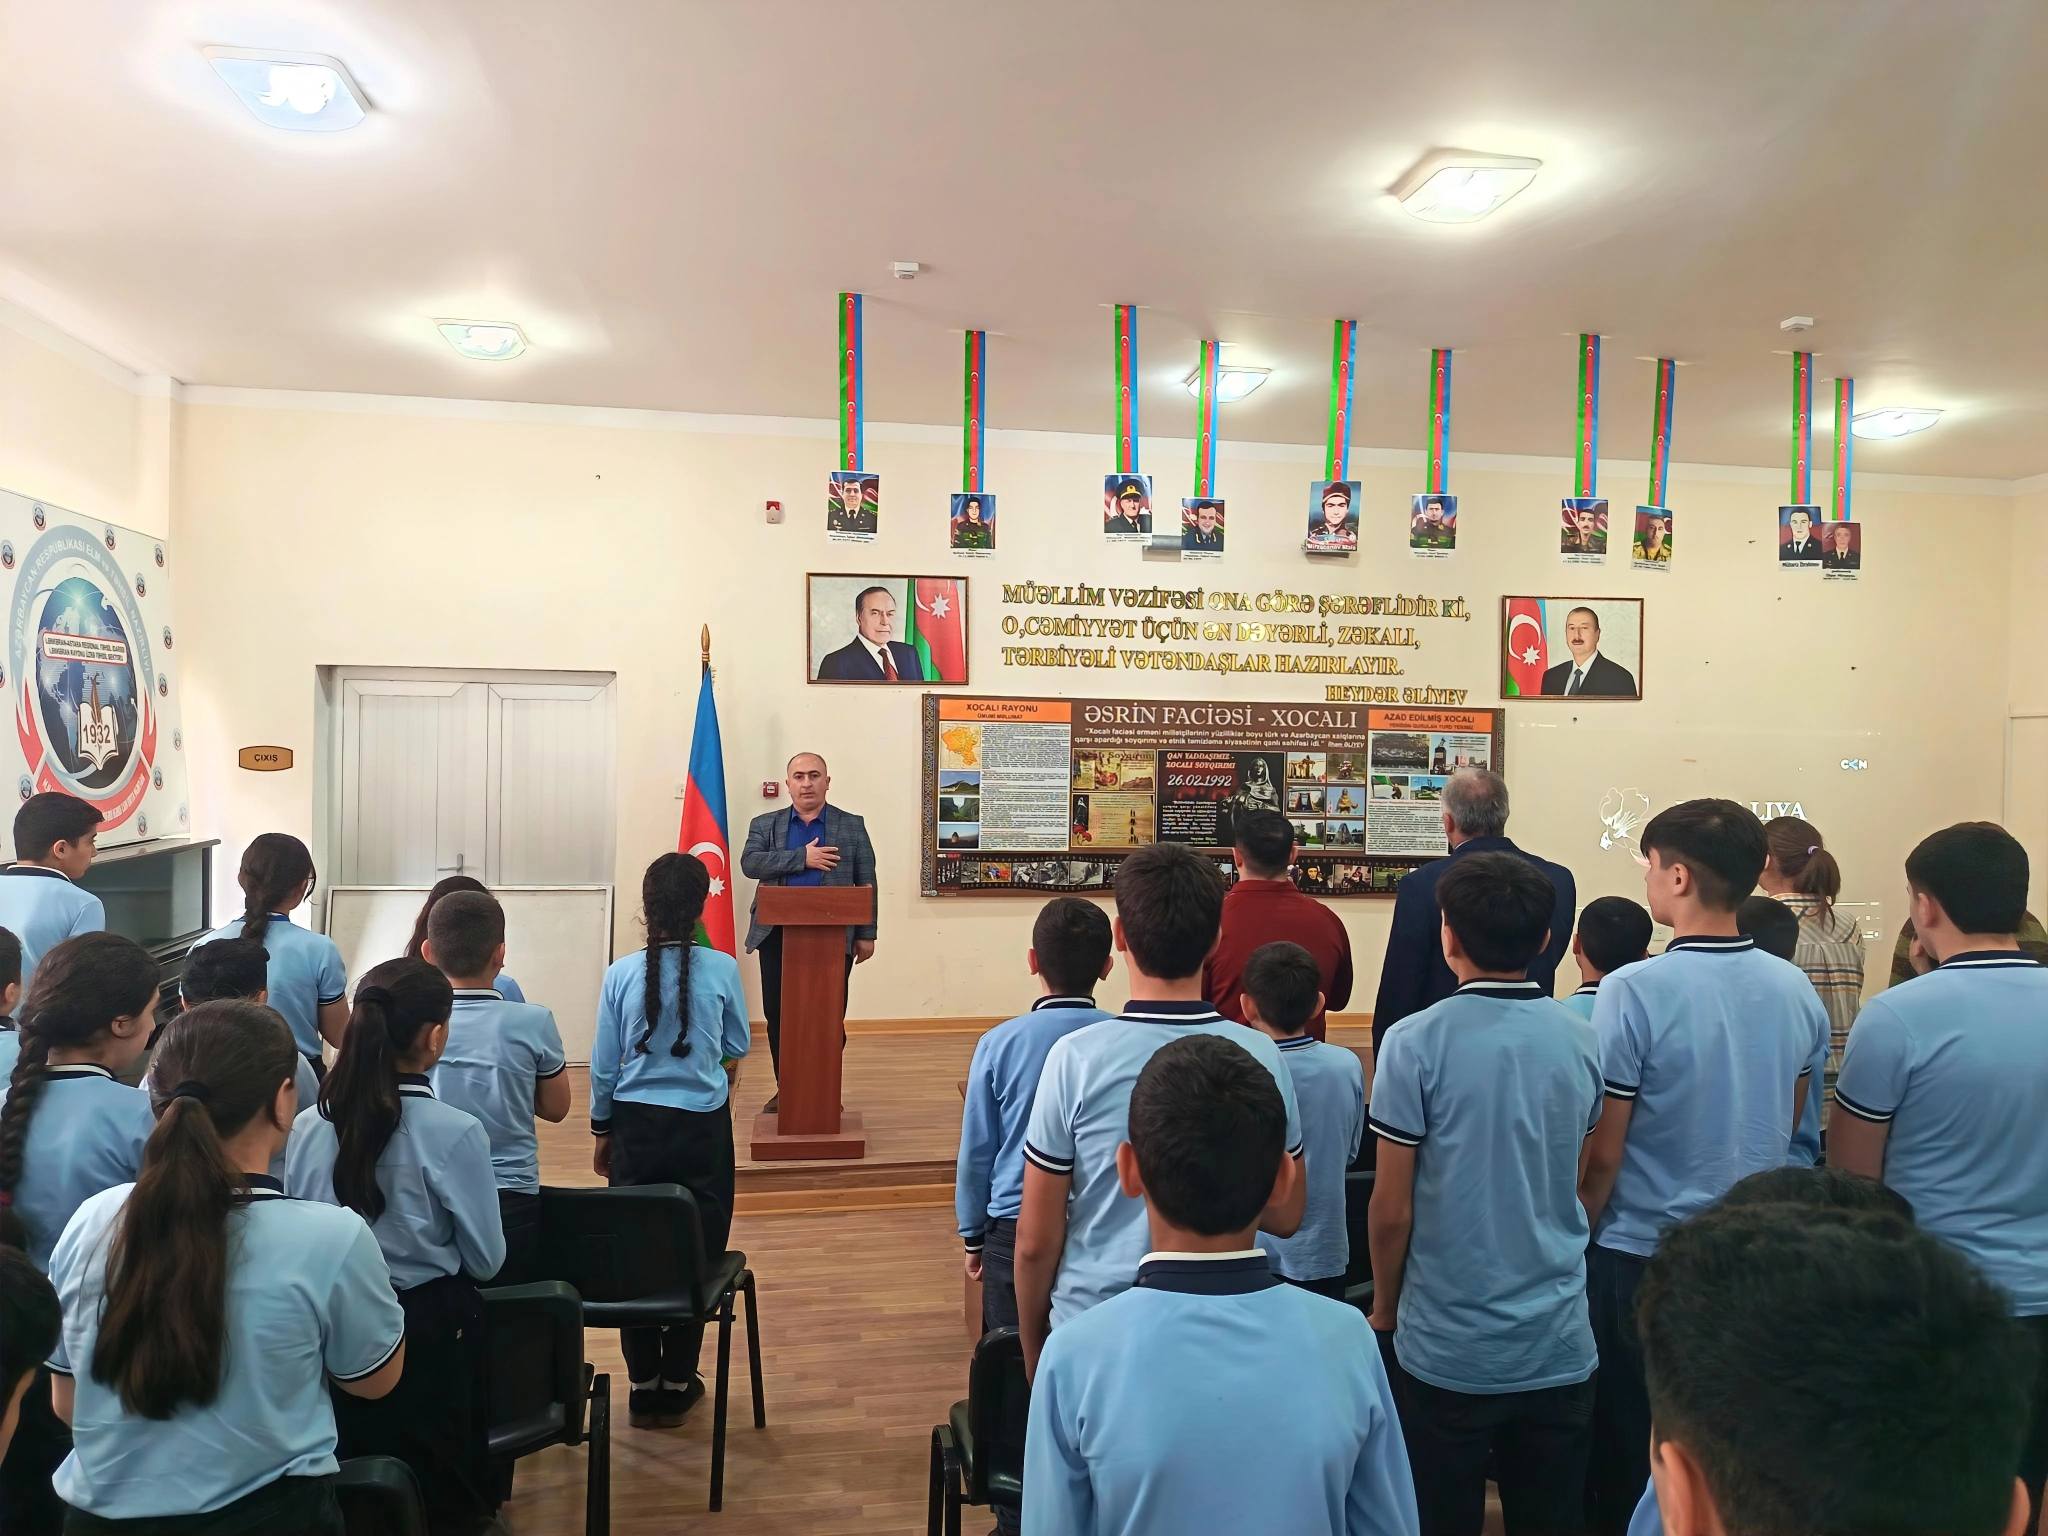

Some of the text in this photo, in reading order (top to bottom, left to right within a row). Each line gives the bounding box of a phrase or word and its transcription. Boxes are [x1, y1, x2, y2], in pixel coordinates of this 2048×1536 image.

[1002, 580, 1471, 621] MÜƏLLİM VƏZİFƏSİ ONA GÖRƏ ŞƏRƏFLİDİR Kİ,
[1141, 616, 1199, 643] ÜÇÜN
[1203, 621, 1232, 641] ƏN
[1236, 621, 1334, 647] DƏYƏRLİ,
[1337, 626, 1421, 649] ZƏKALI,
[1002, 644, 1405, 675] TƏRBİYƏLİ VƏTƏNDAŞLAR HAZIRLAYIR.
[1325, 684, 1468, 705] HEYDƏR ƏLİYEV
[966, 703, 1038, 713] XOCALI RAYONU
[1084, 702, 1157, 724] ƏSRİN
[1162, 703, 1252, 726] FACİƏSİ
[1271, 710, 1357, 728] XOCALI
[1384, 713, 1475, 724] AZAD EDİLMİŞ XOCALI
[83, 724, 110, 743] 1932
[1166, 752, 1183, 760] QAN
[1166, 761, 1193, 769] XOCALI
[1167, 774, 1233, 787] 26.02.1992
